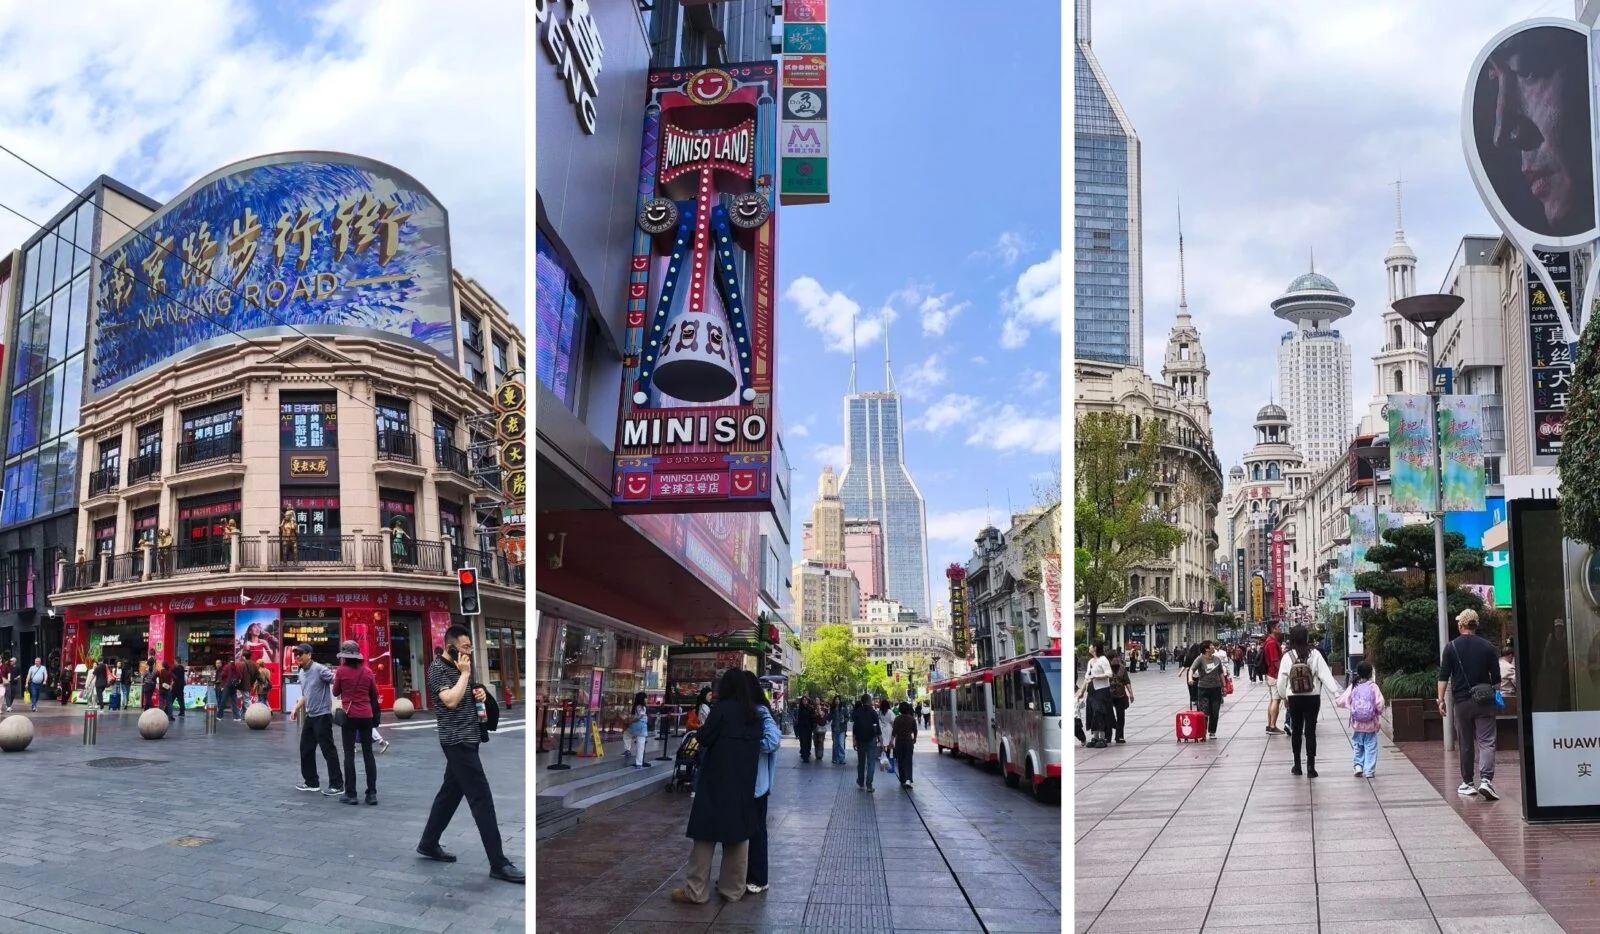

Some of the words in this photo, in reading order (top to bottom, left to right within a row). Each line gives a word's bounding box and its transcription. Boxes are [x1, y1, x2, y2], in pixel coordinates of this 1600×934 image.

[665, 132, 711, 170] MINISO
[714, 128, 749, 164] LAND
[110, 194, 412, 312] 南京路步行街
[138, 290, 233, 329] NANJING
[245, 273, 339, 306] ROAD
[624, 414, 766, 446] MINISO
[660, 474, 692, 482] MINISO
[695, 473, 720, 482] LAND
[660, 482, 719, 495] 全球壹号店
[1553, 737, 1600, 749] HUAW
[1577, 762, 1592, 777] 实
